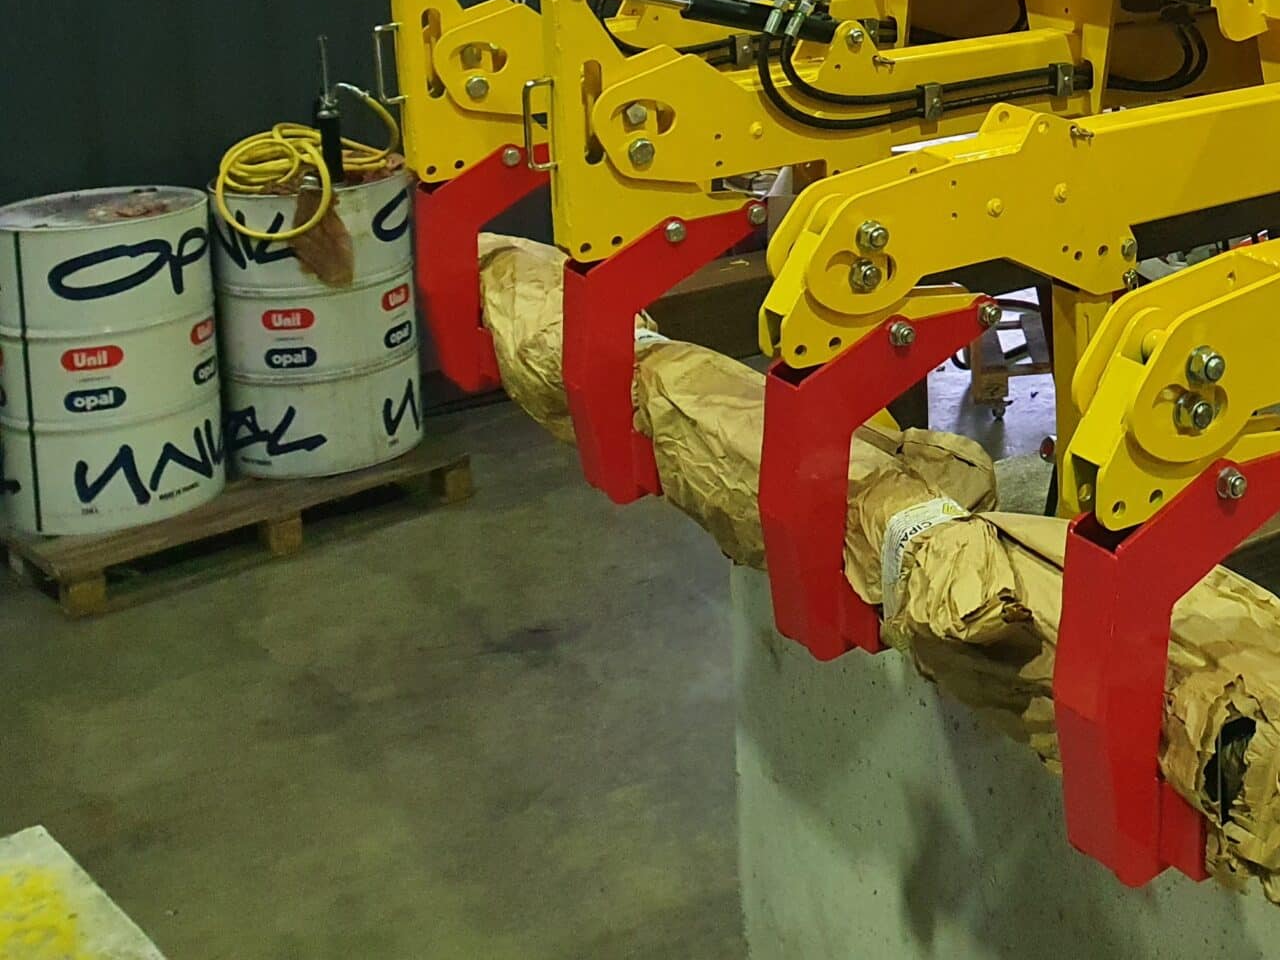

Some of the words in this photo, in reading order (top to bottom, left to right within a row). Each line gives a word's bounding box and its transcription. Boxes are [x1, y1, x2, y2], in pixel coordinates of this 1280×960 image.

[271, 313, 301, 327] Unil
[72, 350, 108, 368] Unil
[271, 350, 307, 368] opal
[73, 390, 115, 410] opal
